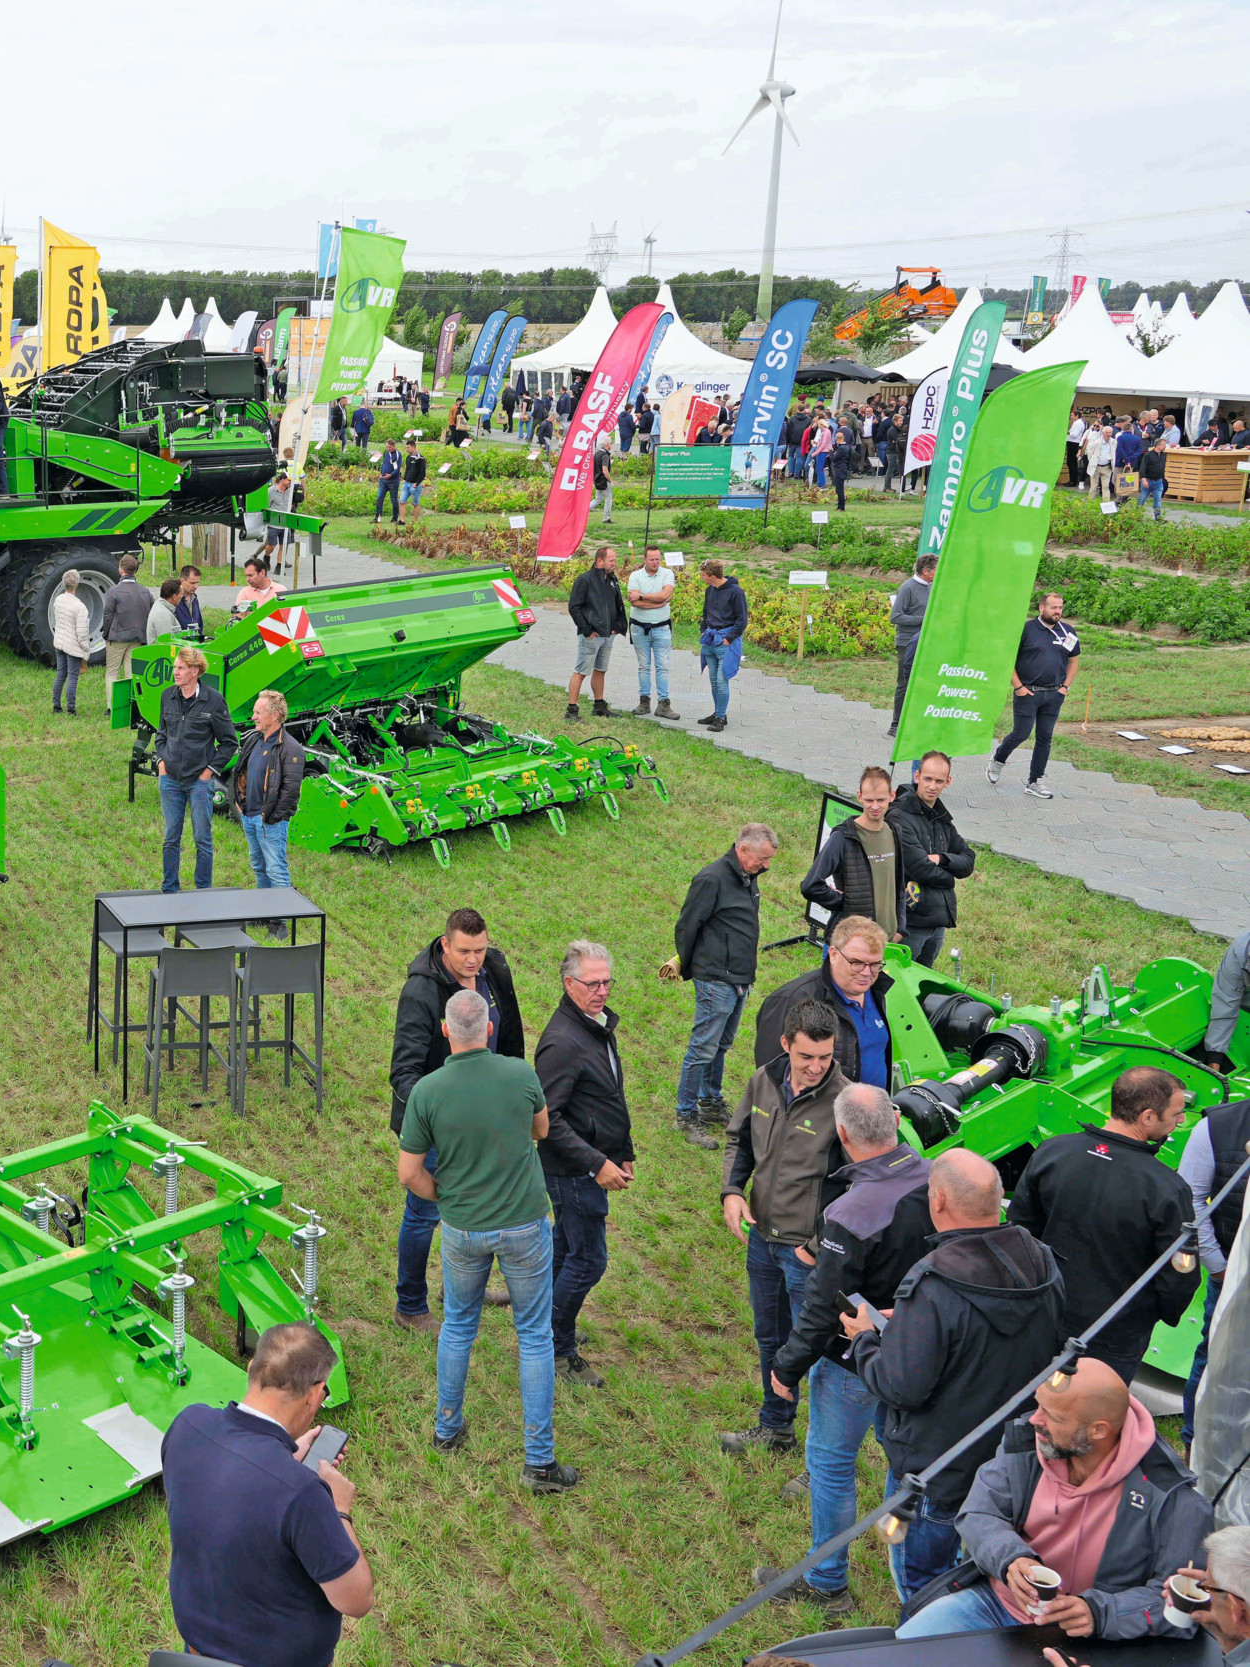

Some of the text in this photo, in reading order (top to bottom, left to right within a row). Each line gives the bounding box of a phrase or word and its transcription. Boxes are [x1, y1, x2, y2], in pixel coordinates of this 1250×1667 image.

[344, 278, 397, 313] AVR
[66, 264, 84, 356] ROPA
[339, 356, 369, 367] PASSION.
[765, 328, 794, 370] SC
[339, 370, 363, 379] POWER.
[956, 328, 989, 402] Plus
[676, 381, 730, 393] Kglinger
[571, 371, 615, 451] BASF
[921, 385, 937, 430] HZPC
[576, 473, 588, 491] We
[971, 466, 1048, 512] AVR
[324, 613, 346, 623] Ceres
[228, 637, 264, 668] Ceres 440
[148, 657, 175, 685] AV
[937, 664, 988, 682] Passion.
[937, 684, 977, 700] Power.
[924, 704, 982, 723] Potatoes.
